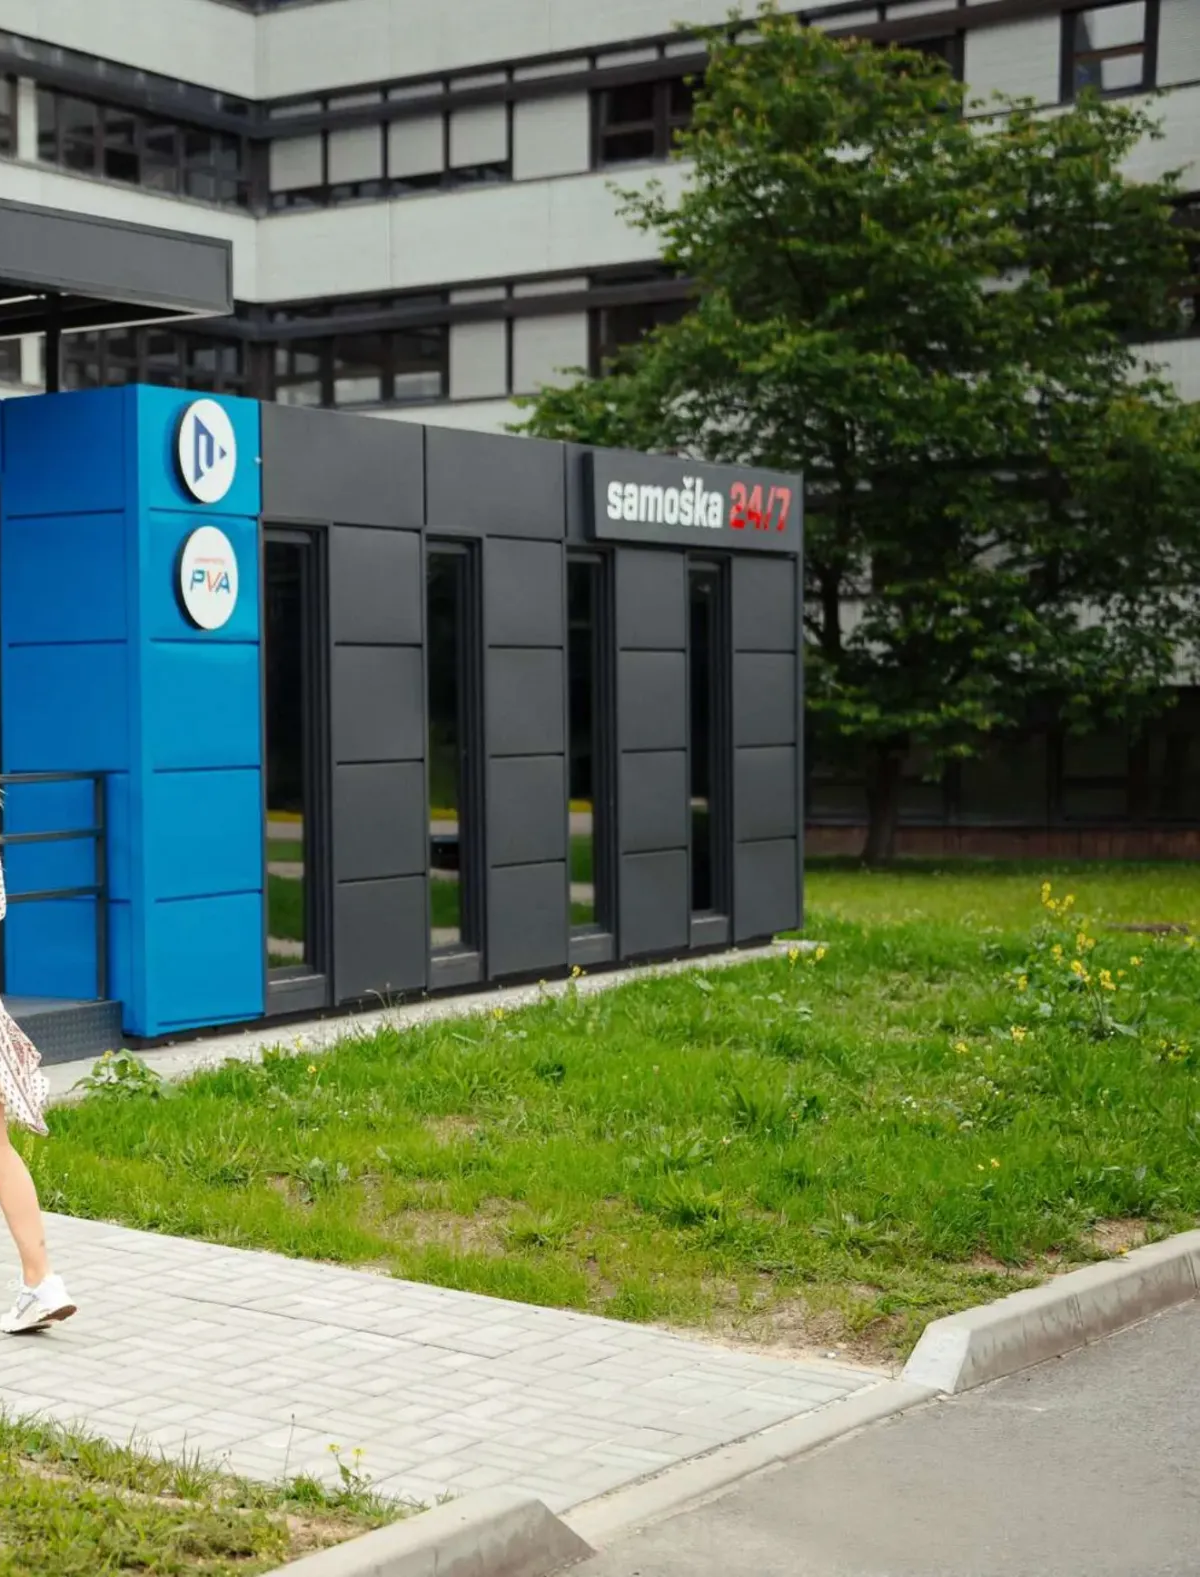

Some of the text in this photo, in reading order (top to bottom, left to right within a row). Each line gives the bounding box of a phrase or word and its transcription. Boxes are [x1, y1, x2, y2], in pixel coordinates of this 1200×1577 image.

[607, 475, 792, 532] samoška 24/7
[190, 569, 230, 594] PVA
